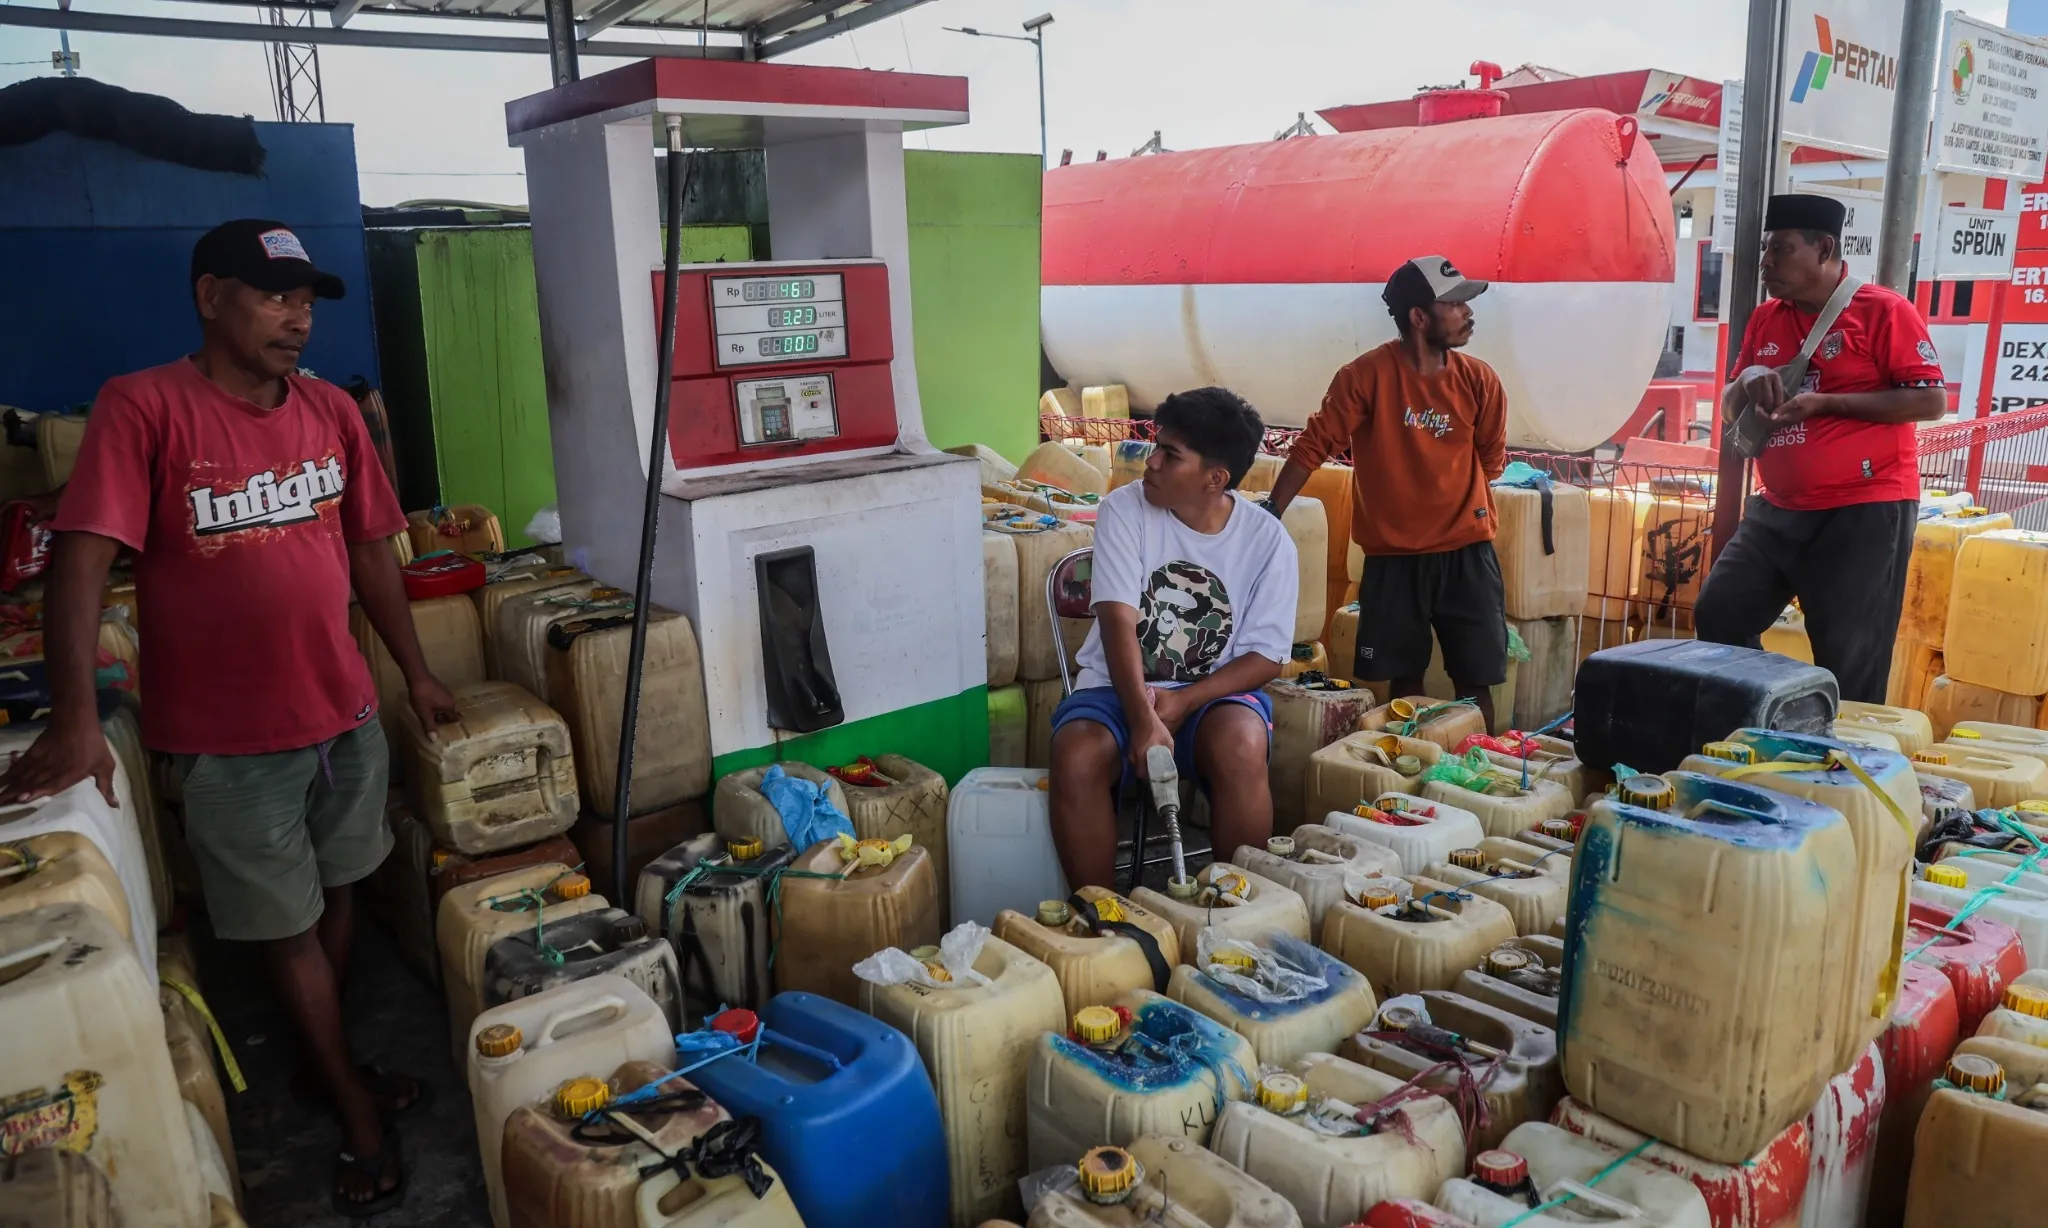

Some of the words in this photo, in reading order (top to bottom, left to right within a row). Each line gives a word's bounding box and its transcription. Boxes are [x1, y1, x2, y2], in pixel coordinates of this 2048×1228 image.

[1669, 91, 1711, 110] PERTAMINA
[1969, 217, 1994, 230] UNIT
[1843, 235, 1872, 256] PERTAMINA
[1952, 229, 2006, 257] SPBUN
[727, 287, 740, 298] Rp
[731, 344, 745, 353] Rp
[2002, 341, 2048, 359] DEX
[190, 454, 346, 534] Infight
